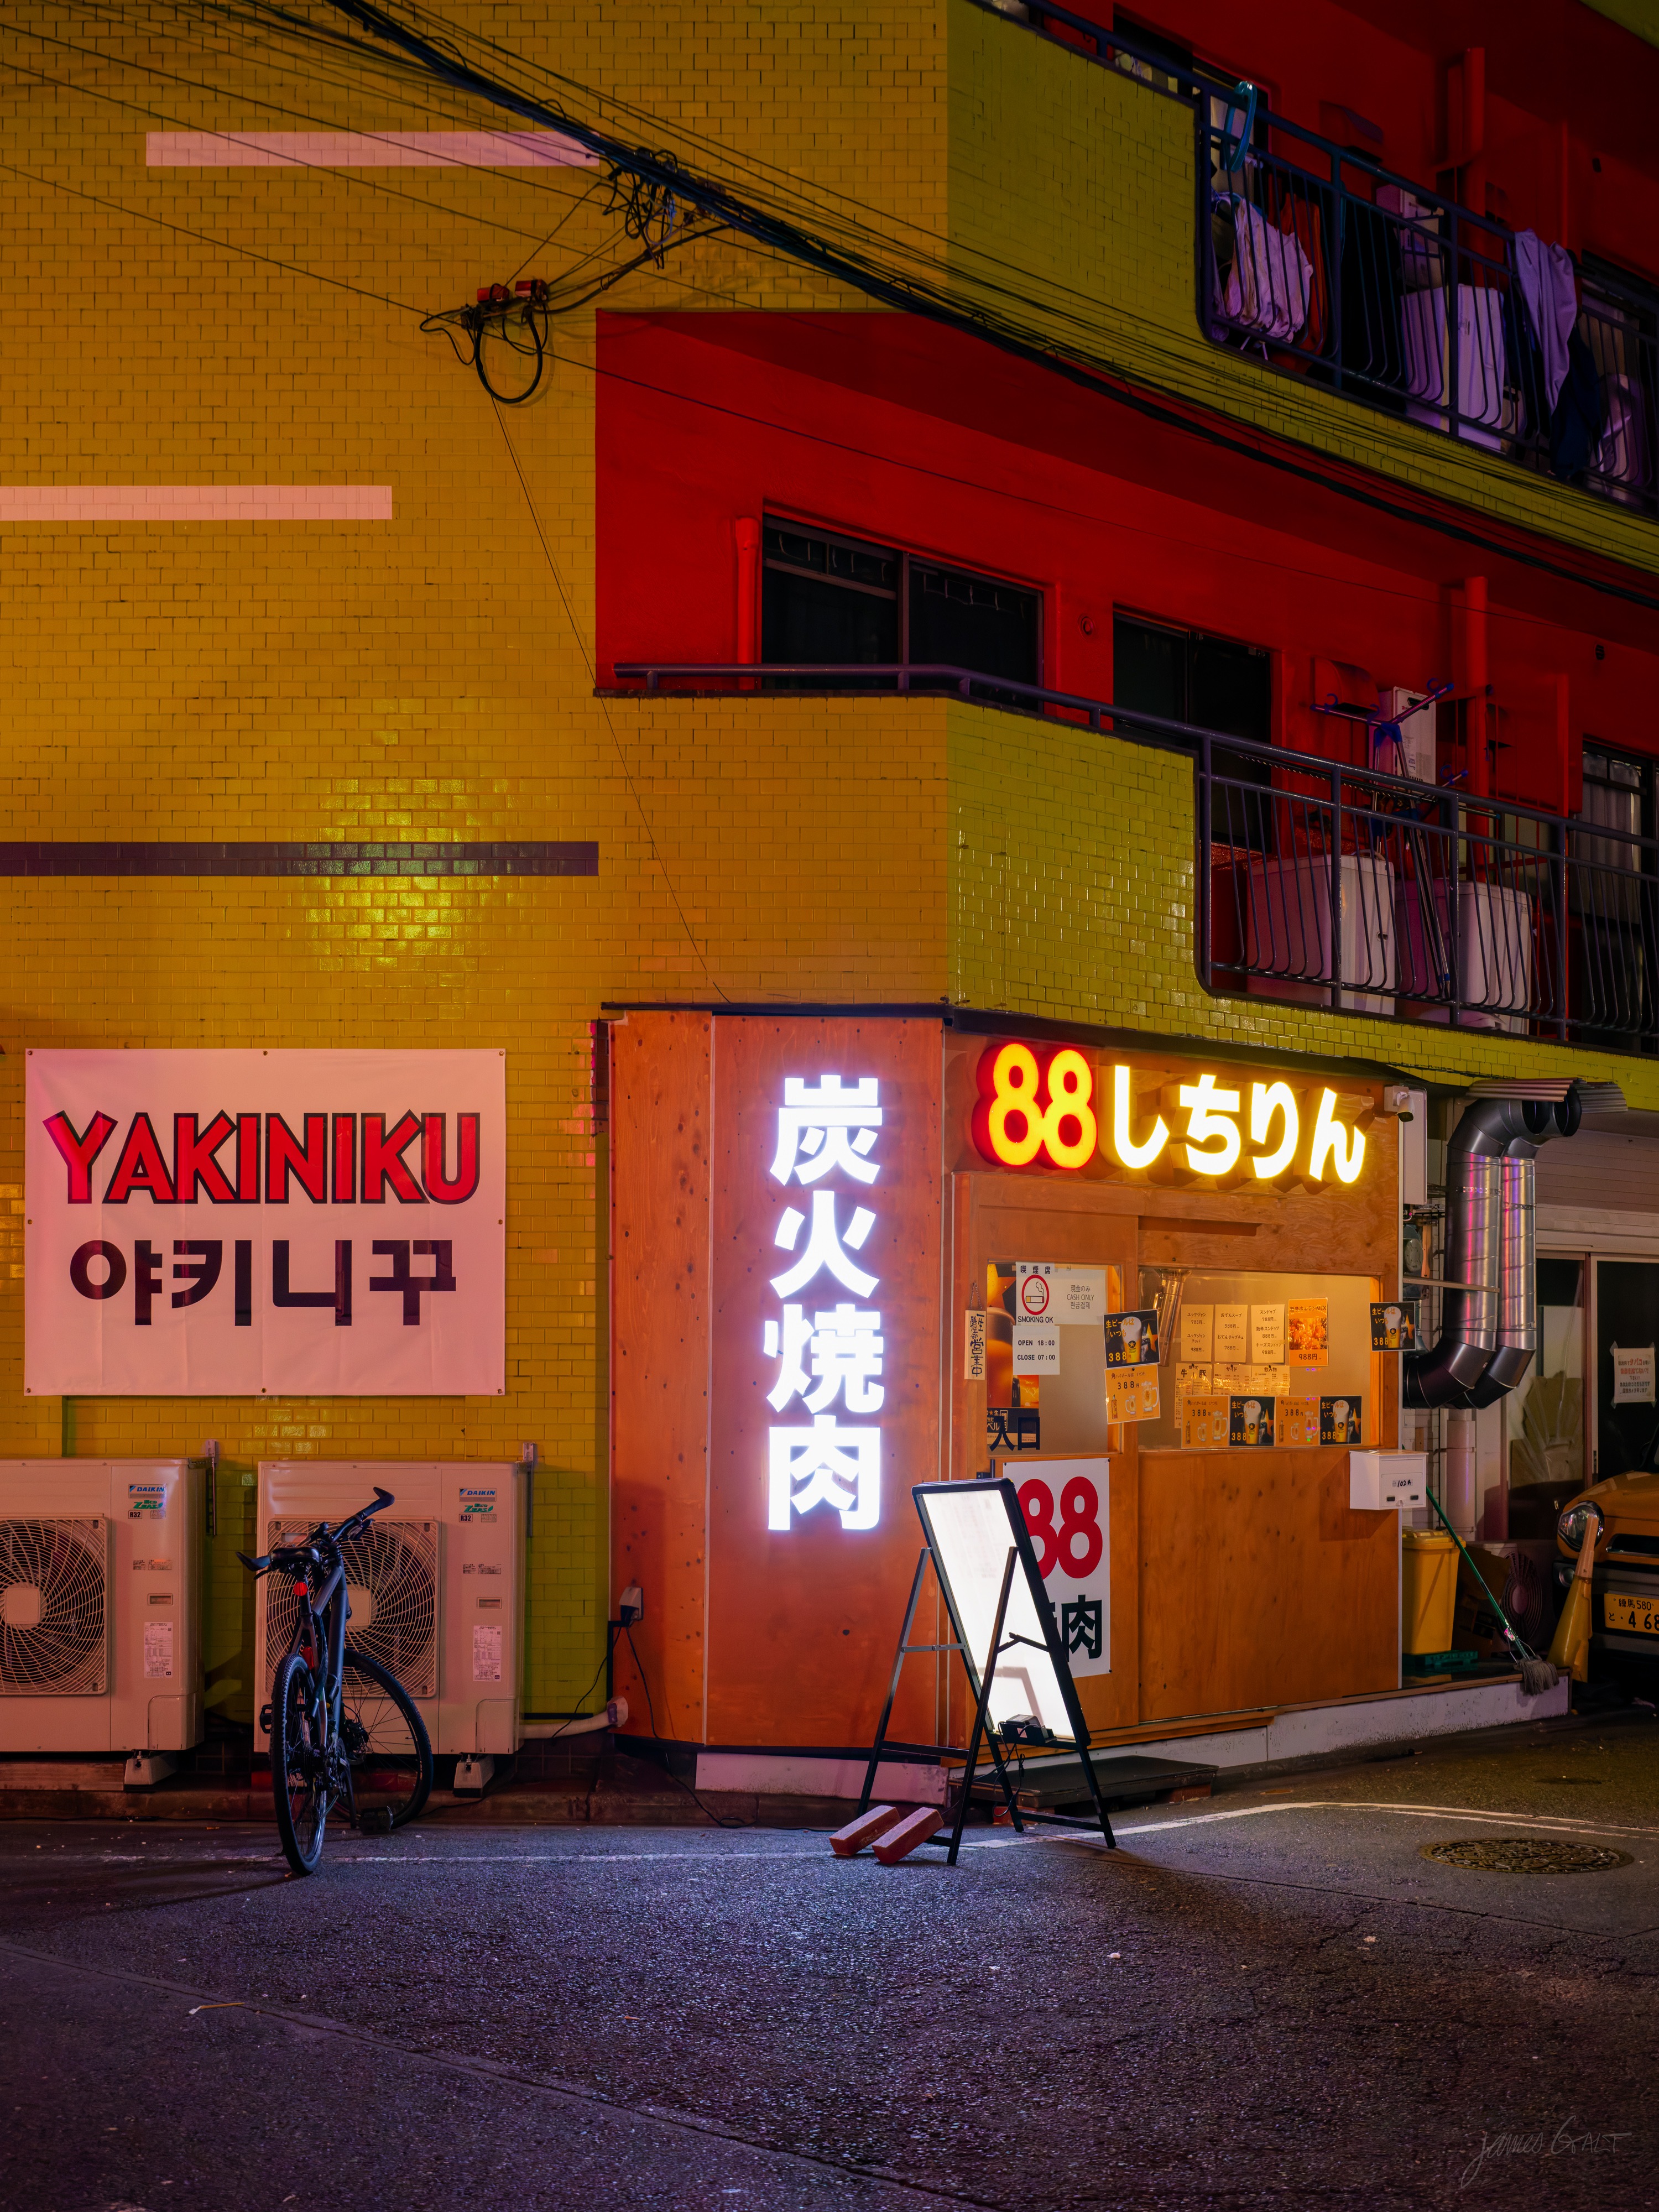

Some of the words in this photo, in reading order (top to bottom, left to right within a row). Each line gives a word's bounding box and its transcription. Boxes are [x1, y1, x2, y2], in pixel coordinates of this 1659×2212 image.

[975, 1043, 1097, 1170] 88
[1113, 1064, 1365, 1183] しちりん
[42, 1109, 481, 1204] YAKINIKU
[70, 1240, 457, 1326] 야키니꾸
[1020, 1265, 1051, 1274] 喫煙席
[763, 1074, 885, 1531] 炭火焼肉
[1105, 1318, 1135, 1328] 生ビールは
[1110, 1328, 1126, 1338] いつも
[1181, 1368, 1187, 1378] 牛
[1198, 1369, 1207, 1378] 豚
[989, 1416, 1040, 1452] 入口
[1016, 1476, 1103, 1580] 88
[1636, 1600, 1651, 1610] 580
[1050, 1594, 1103, 1662] 肉
